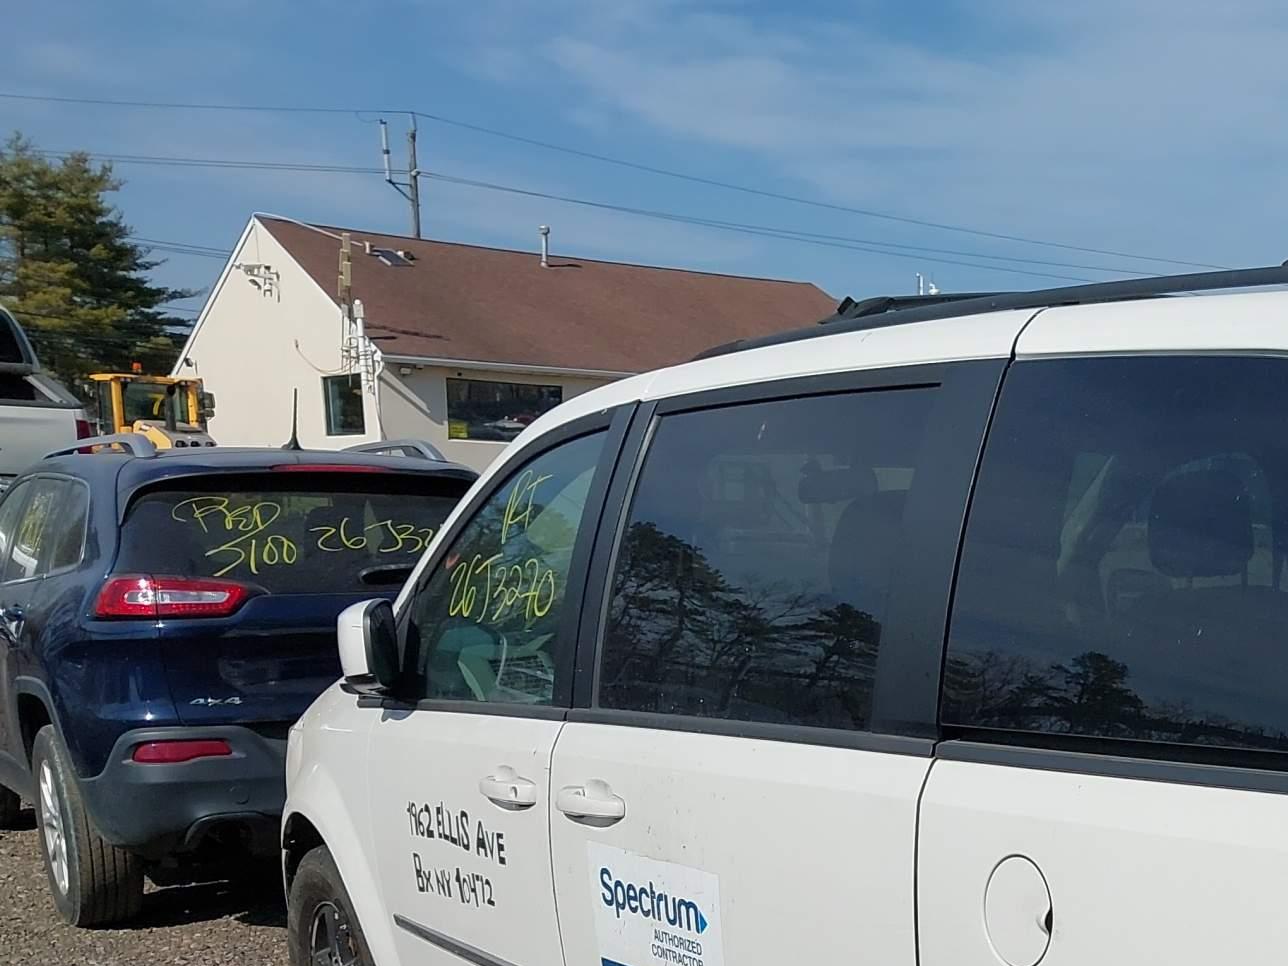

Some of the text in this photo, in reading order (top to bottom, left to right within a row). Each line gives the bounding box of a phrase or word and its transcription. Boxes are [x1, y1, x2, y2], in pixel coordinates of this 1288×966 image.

[450, 552, 555, 624] 26J3270
[406, 801, 506, 865] 1962 ELLIS AVE
[433, 867, 452, 898] NY
[455, 867, 496, 908] 10472
[600, 867, 704, 934] Spectrum
[653, 928, 703, 956] AUTHORIZED
